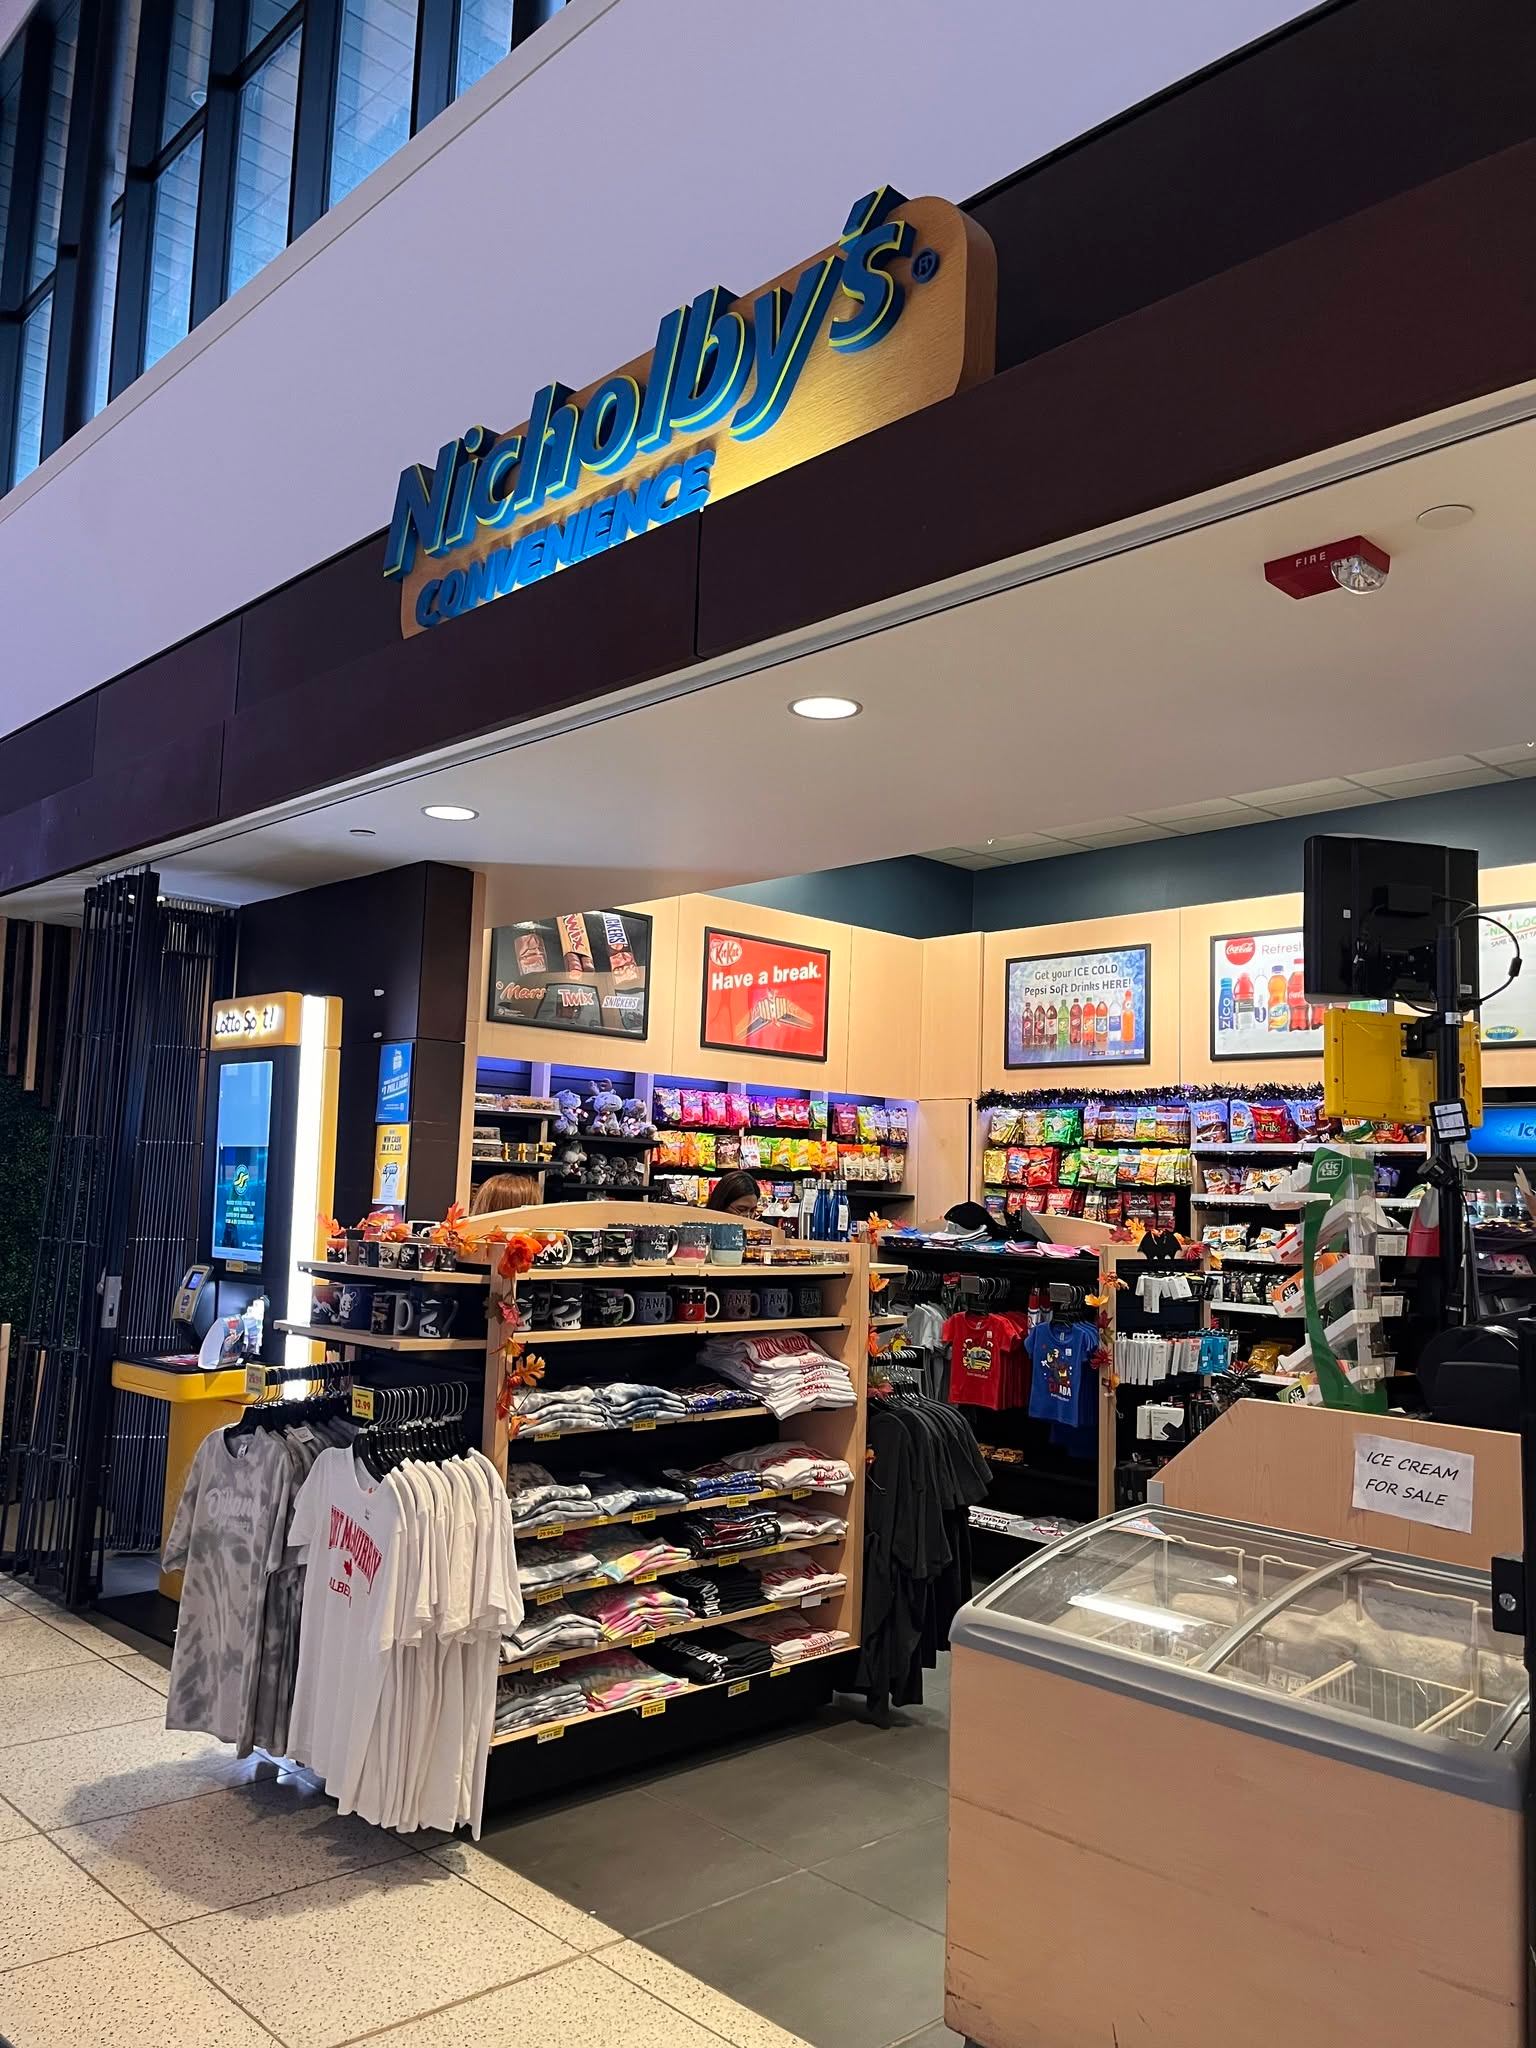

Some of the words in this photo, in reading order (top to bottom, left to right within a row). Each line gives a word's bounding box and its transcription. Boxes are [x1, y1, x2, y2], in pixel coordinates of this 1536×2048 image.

[384, 185, 917, 583] Nicholby's
[416, 449, 716, 629] CONVENIENCE
[1295, 551, 1326, 568] FIRE
[564, 914, 585, 952] wix
[1226, 942, 1254, 955] Coca-Cola
[711, 972, 754, 991] Have
[758, 970, 769, 985] a
[773, 961, 822, 983] break.
[1034, 971, 1050, 981] Get
[1051, 969, 1072, 982] your
[1074, 967, 1089, 977] ICE
[1091, 964, 1118, 975] COLD
[500, 982, 547, 1001] Mars
[558, 988, 595, 1007] Twix
[603, 995, 640, 1009] SNICKERS
[1024, 985, 1047, 997] Pepsi
[1050, 984, 1069, 995] Soft
[1070, 981, 1100, 993] Drinks
[1102, 978, 1132, 990] HERE!
[214, 1009, 241, 1035] Lotto
[1219, 997, 1231, 1029] zico
[1321, 1168, 1339, 1176] tac
[1325, 1160, 1340, 1170] tic
[1366, 1451, 1394, 1467] ICE
[1397, 1458, 1459, 1481] CREAM
[1365, 1478, 1399, 1496] FOR
[1402, 1486, 1448, 1506] SALE
